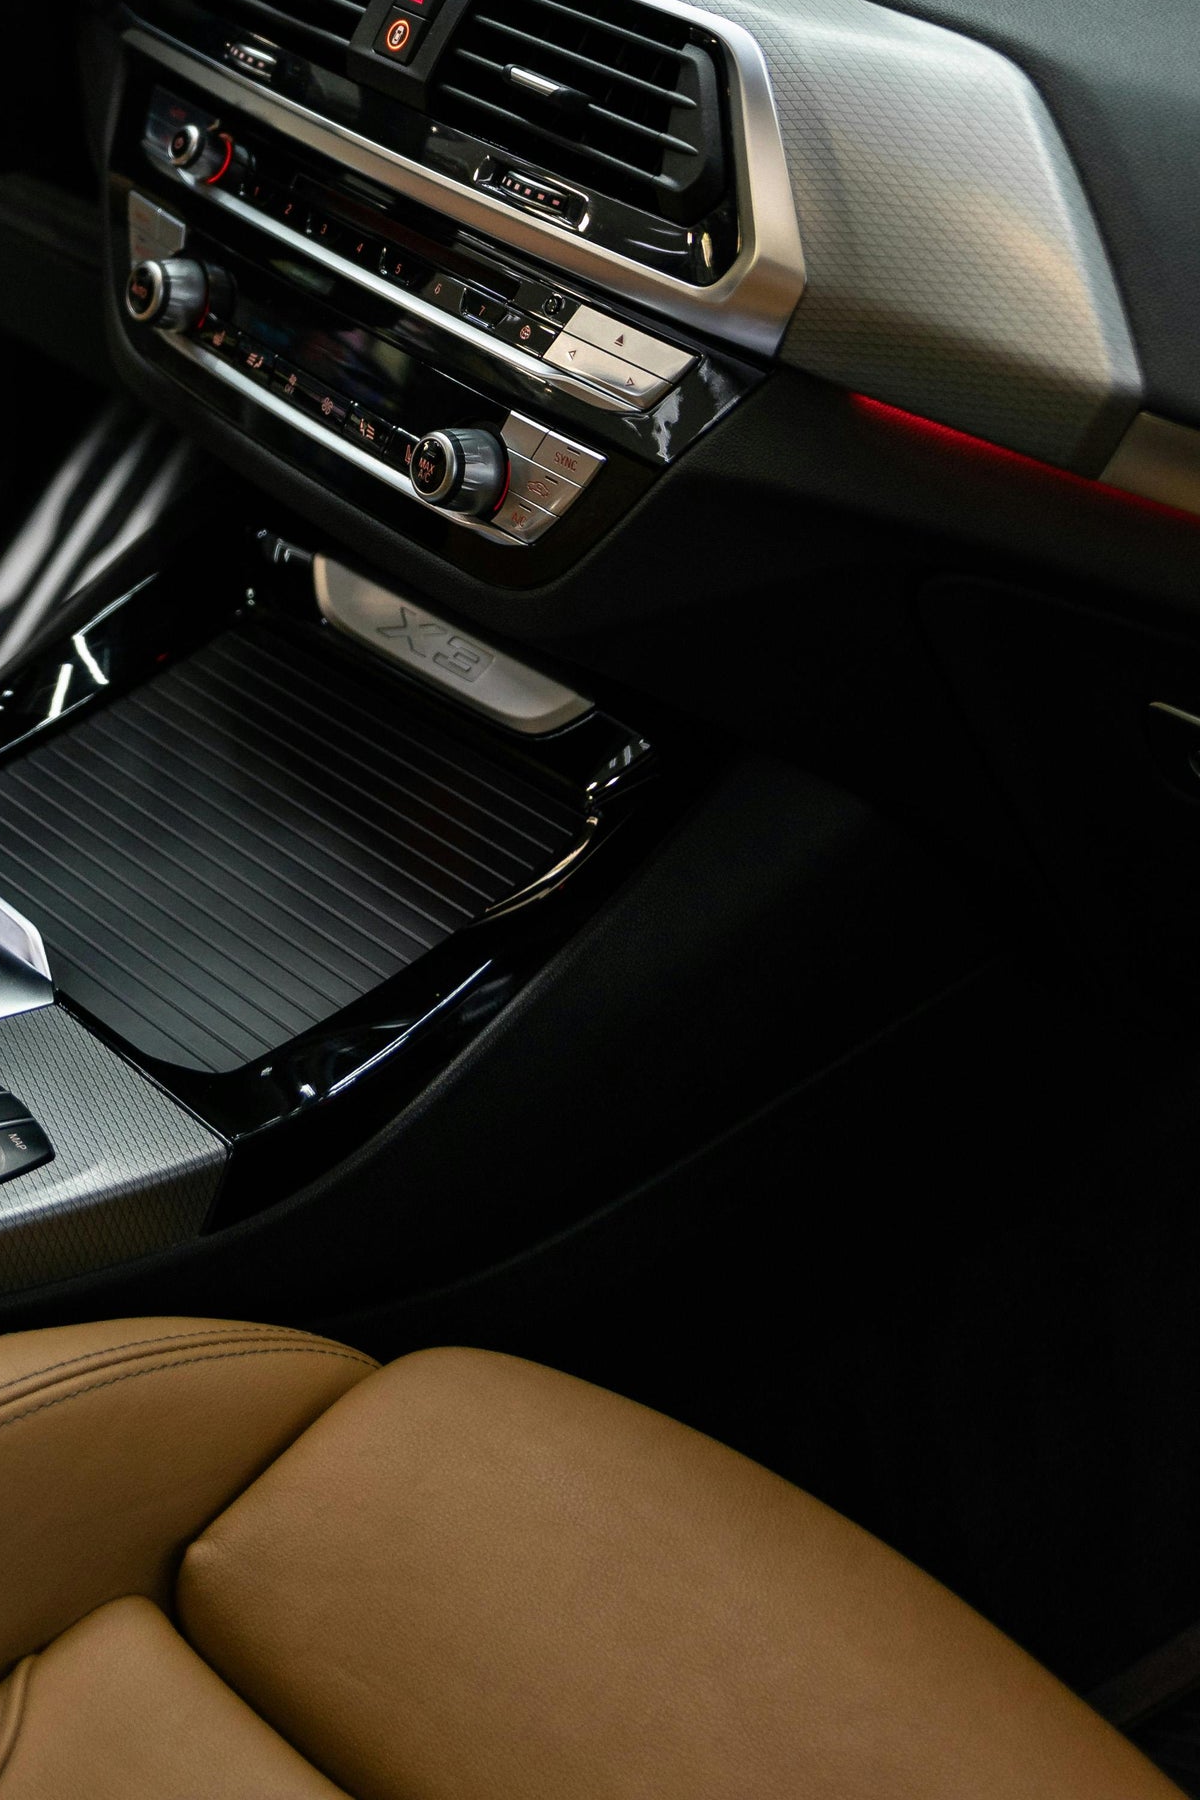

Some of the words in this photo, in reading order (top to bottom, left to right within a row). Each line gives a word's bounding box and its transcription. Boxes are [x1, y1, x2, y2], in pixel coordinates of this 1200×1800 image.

[284, 203, 293, 215] 2
[320, 223, 329, 235] 3
[394, 263, 403, 275] 5
[434, 283, 443, 295] 6
[478, 305, 487, 316] 7
[553, 451, 578, 472] SYNC
[376, 606, 496, 683] X3
[8, 1133, 28, 1151] MAP
